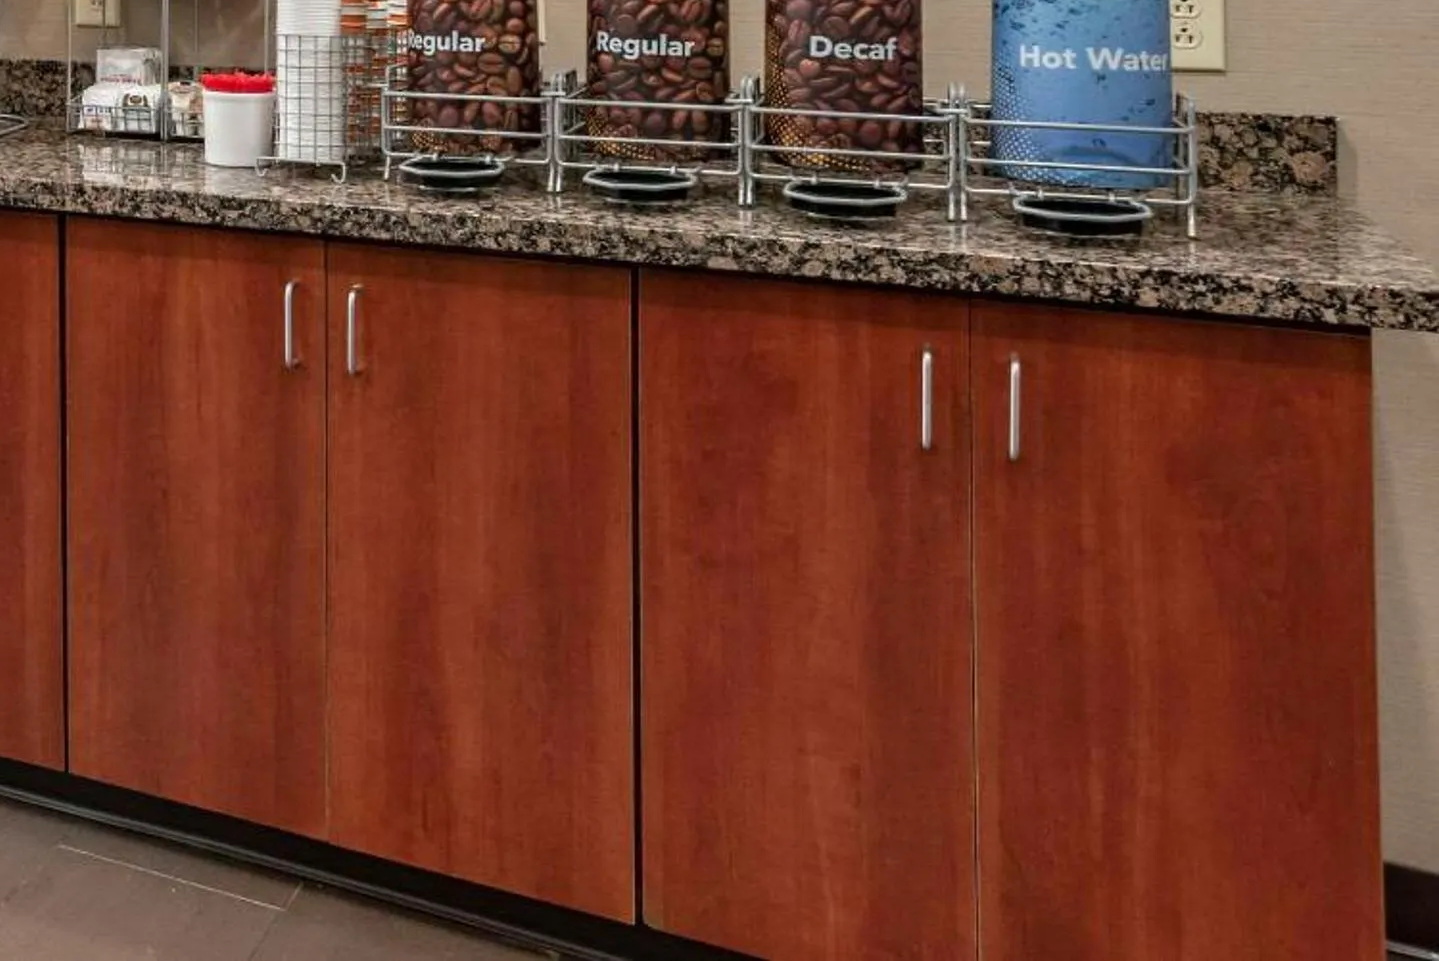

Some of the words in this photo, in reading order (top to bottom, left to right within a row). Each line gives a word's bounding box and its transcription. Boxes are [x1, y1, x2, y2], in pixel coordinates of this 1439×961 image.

[596, 29, 696, 60] Regular
[809, 35, 898, 61] Decaf
[1019, 44, 1077, 70] Hot
